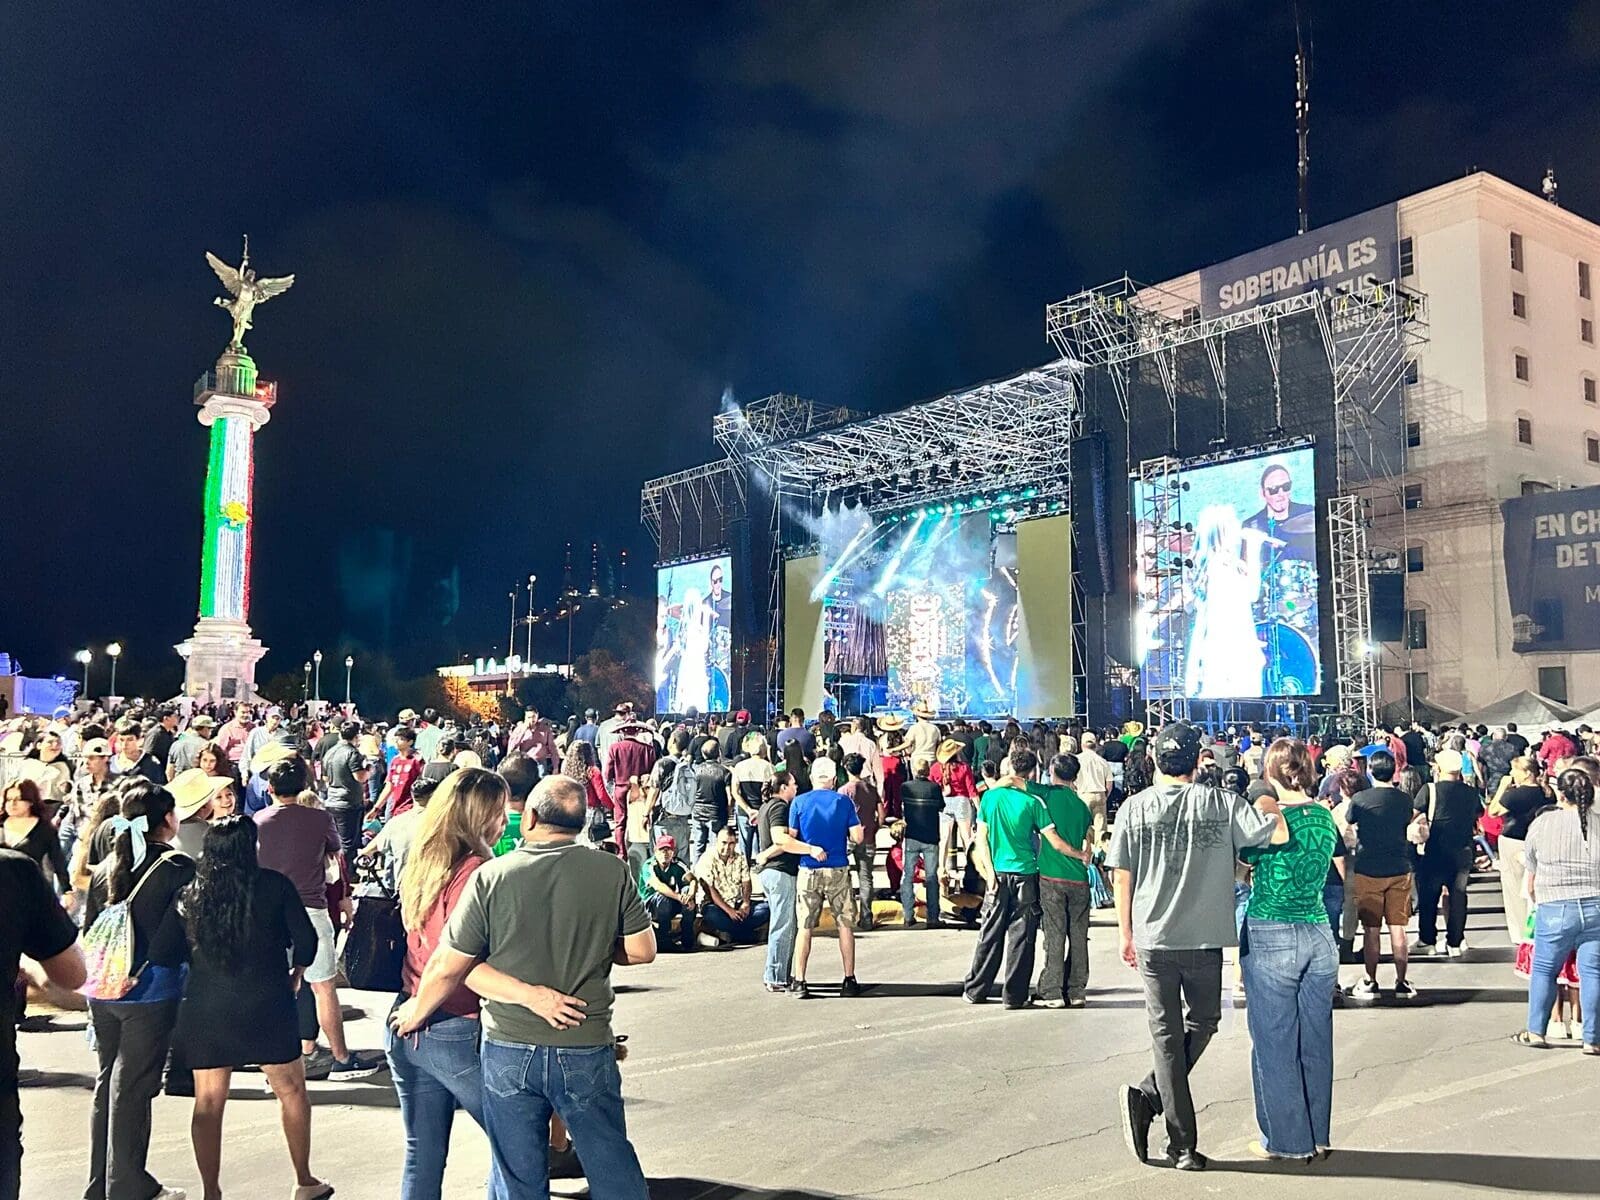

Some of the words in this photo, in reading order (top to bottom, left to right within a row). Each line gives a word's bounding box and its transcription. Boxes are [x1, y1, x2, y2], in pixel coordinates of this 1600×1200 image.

[1219, 244, 1344, 310] SOBERANÍA
[1347, 237, 1377, 269] ES
[1535, 513, 1566, 539] EN
[1556, 542, 1588, 568] DE
